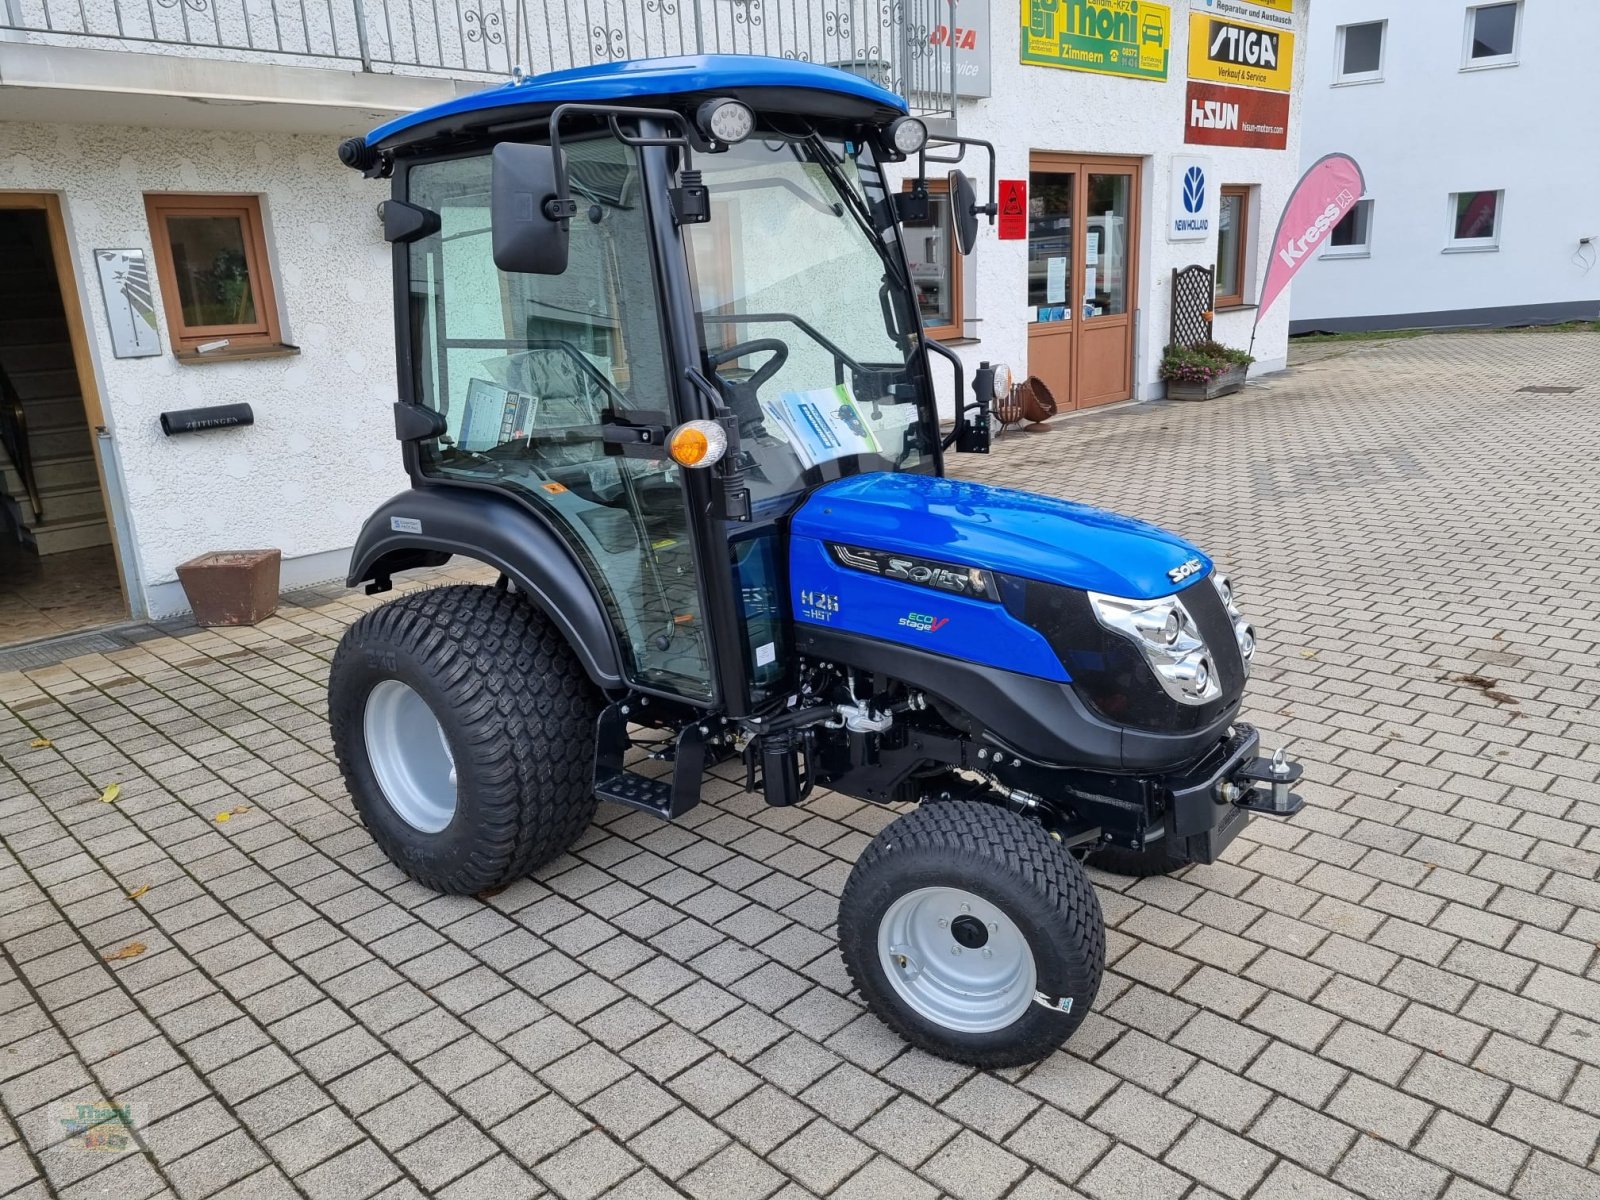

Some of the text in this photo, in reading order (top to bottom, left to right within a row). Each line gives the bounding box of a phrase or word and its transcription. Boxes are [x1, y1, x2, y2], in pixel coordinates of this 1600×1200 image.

[1062, 0, 1139, 45] Thoni
[1216, 1, 1292, 25] Reparatur und Austausch
[1062, 43, 1104, 63] Zimmern
[1210, 26, 1276, 67] STIGA
[1218, 66, 1267, 82] Verkauf & Service
[1242, 121, 1284, 134] hisun-motors.com
[1278, 202, 1341, 269] Kress
[185, 416, 239, 429] ZEITUNGEN
[885, 558, 968, 592] Solis
[908, 612, 933, 624] ECO
